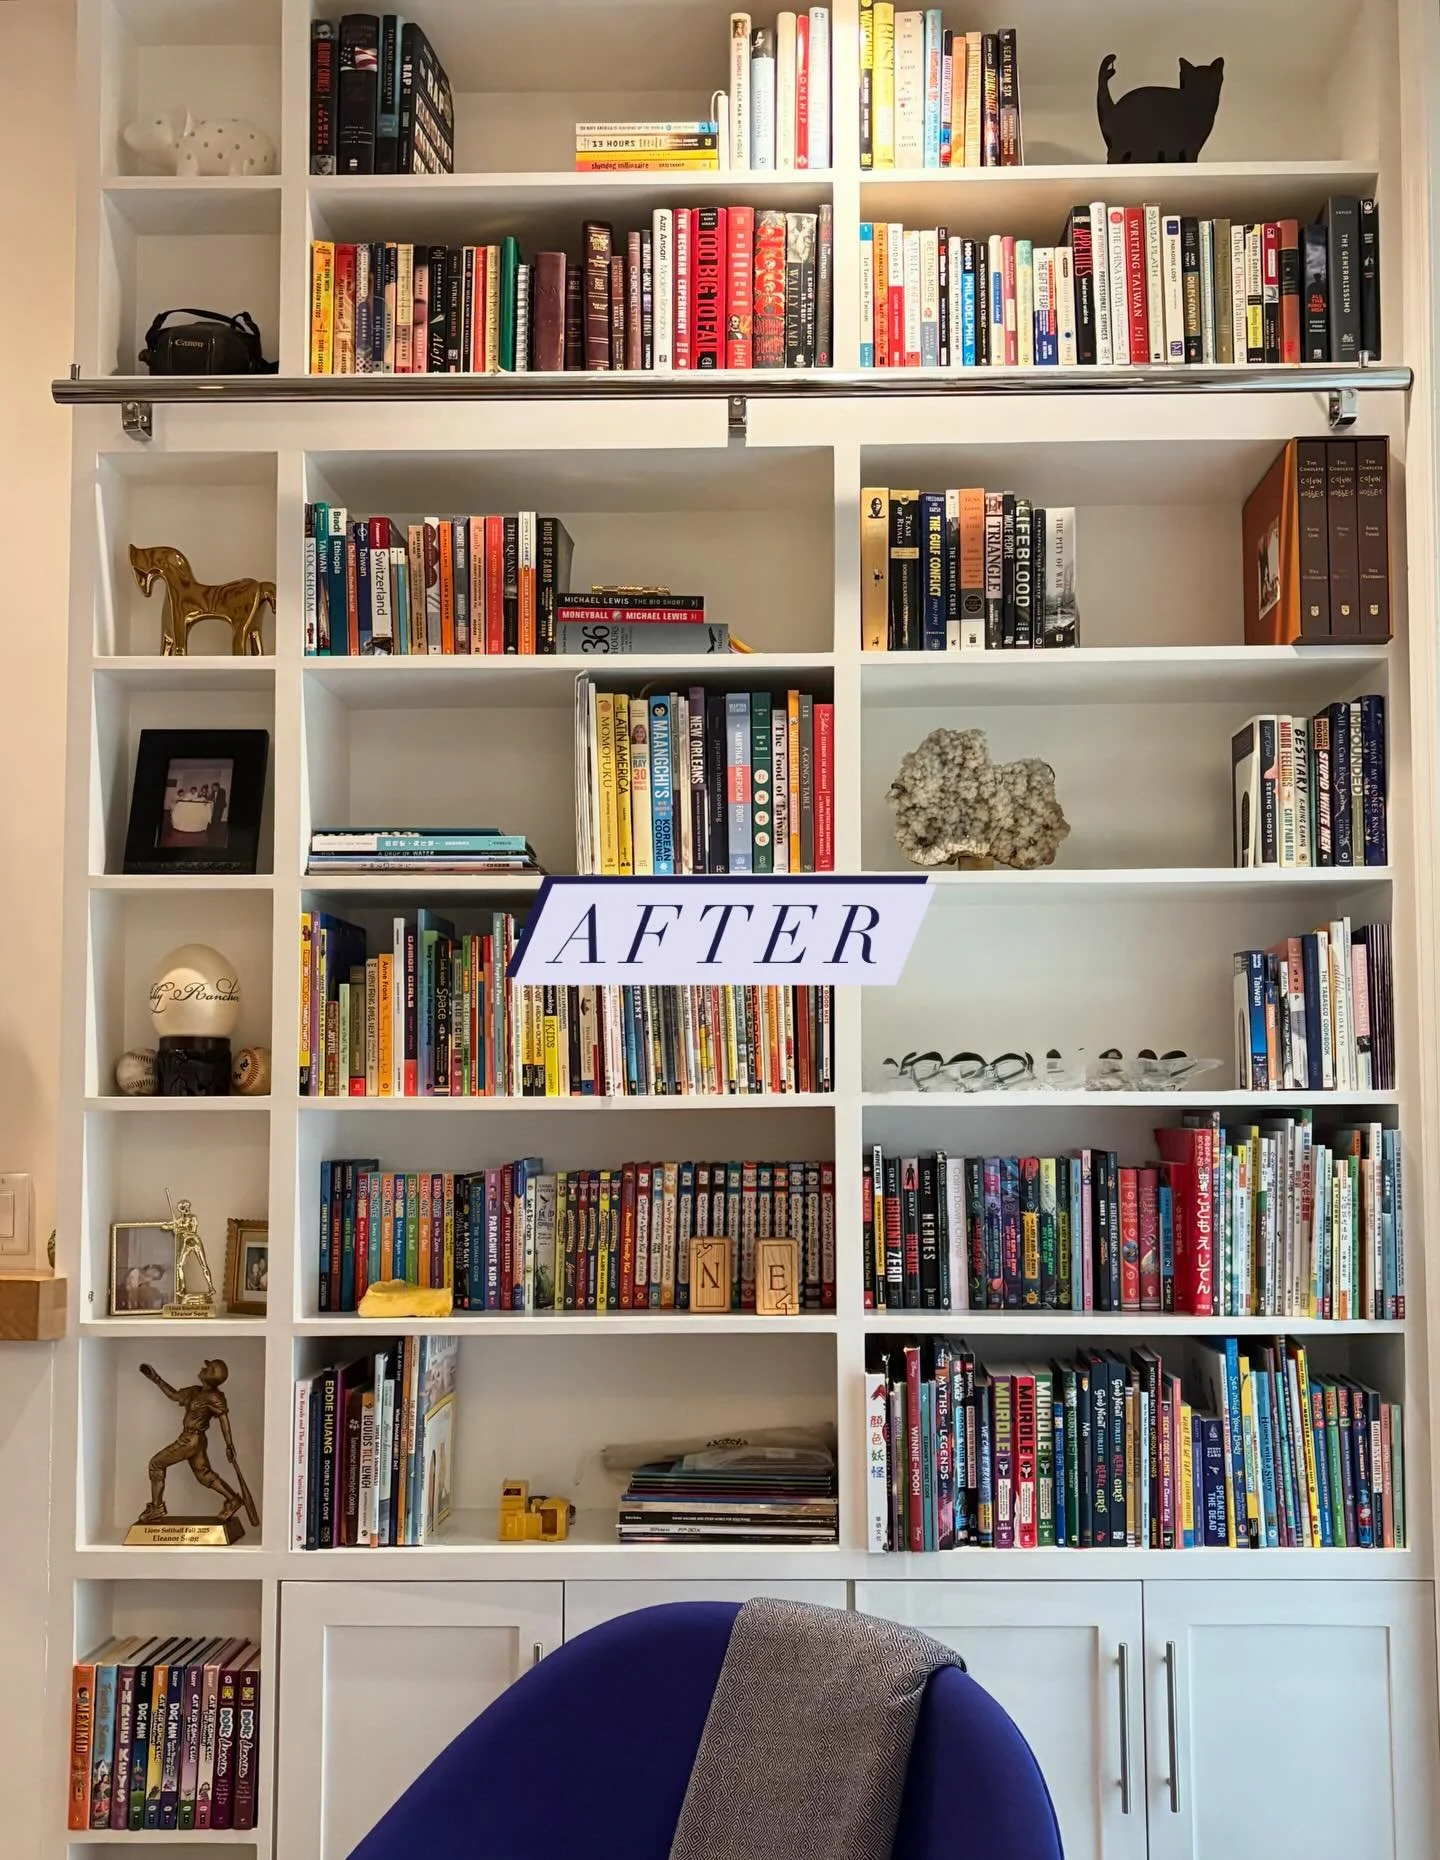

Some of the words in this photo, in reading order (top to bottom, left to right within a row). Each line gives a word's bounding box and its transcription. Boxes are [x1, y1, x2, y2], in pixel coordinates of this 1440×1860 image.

[403, 64, 412, 85] RAP
[985, 68, 996, 114] TROUBLEMAKER
[678, 213, 687, 229] THE
[660, 234, 668, 260] Ansari
[678, 233, 687, 275] BECKHAM
[698, 229, 717, 260] TOO
[1073, 228, 1092, 277] APPETITES
[1130, 219, 1140, 269] WRITING
[1233, 232, 1242, 262] Choke
[698, 265, 717, 293] BIG
[1038, 261, 1047, 271] THE
[1039, 272, 1048, 285] GIFT
[1234, 266, 1242, 294] Chuck
[789, 269, 799, 310] WALLY
[1132, 272, 1142, 317] TAIWAN
[1342, 251, 1350, 313] GENERALISSIMO
[678, 279, 687, 335] EXPERIMENT
[698, 296, 717, 313] TO
[965, 276, 974, 346] PHILADELPHIA
[1039, 295, 1048, 309] FEAR
[659, 300, 667, 339] Romance
[789, 314, 799, 347] LAMB
[174, 339, 204, 347] Canon
[432, 333, 443, 365] Aloft
[698, 321, 718, 353] FAIL
[544, 522, 552, 544] HOUSE
[930, 516, 941, 532] THE
[1004, 514, 1012, 533] MOLE
[544, 548, 551, 556] OF
[930, 534, 941, 556] GULF
[988, 522, 1001, 592] TRIANGLE
[1004, 535, 1013, 559] PEOPLE
[1016, 506, 1030, 607] LIFEBLOOD
[307, 543, 315, 612] STOCKHOLM
[360, 548, 368, 576] Taiwan
[505, 545, 515, 584] QUANTS
[543, 559, 552, 583] CARDS
[930, 558, 941, 596] CONFLICT
[1056, 558, 1063, 568] OF
[375, 552, 387, 616] Switzerland
[564, 596, 600, 604] MICHAEL
[663, 612, 688, 620] LEWIS
[616, 711, 628, 742] LATIN
[690, 716, 703, 737] NEW
[776, 725, 784, 747] The
[601, 716, 611, 788] MOMOFUKU
[653, 720, 668, 798] MAANGCHI'S
[690, 740, 704, 784] ORLEANS
[776, 752, 784, 780] Food
[1294, 729, 1307, 793] BESTIARY
[1351, 710, 1362, 794] IMPOUNDED
[617, 745, 628, 794] AMERICA
[1320, 751, 1329, 789] STUPID
[1371, 769, 1377, 780] MY
[776, 786, 785, 797] of
[776, 801, 786, 844] Taiwan
[1320, 792, 1330, 824] WHITE
[655, 819, 663, 861] COOKING
[662, 819, 671, 861] KOREAN
[1321, 827, 1331, 852] MEN
[1253, 976, 1262, 1006] Taiwan
[546, 1024, 555, 1048] KIDS
[886, 1197, 901, 1248] GROUND
[922, 1213, 935, 1260] HEROES
[489, 1216, 497, 1263] PARACHUTE
[905, 1233, 918, 1276] GRENADE
[489, 1266, 497, 1286] KIDS
[702, 1262, 720, 1288] N
[768, 1264, 787, 1290] E
[887, 1252, 902, 1282] ZERO
[324, 1380, 334, 1412] EDDIE
[938, 1376, 947, 1414] MYTHS
[981, 1425, 988, 1437] WE
[996, 1382, 1010, 1451] MURDLE
[1020, 1385, 1034, 1453] MURDLE
[1037, 1381, 1052, 1450] MURDLE
[1068, 1410, 1076, 1438] NARNIA
[1082, 1422, 1089, 1437] Me
[323, 1414, 333, 1454] HUANG
[940, 1429, 948, 1480] LEGENDS
[982, 1456, 989, 1466] BE
[912, 1469, 920, 1495] POOH
[1216, 1485, 1224, 1520] SPEAKER
[1217, 1522, 1225, 1538] FOR
[138, 1703, 148, 1720] DOG
[170, 1703, 179, 1720] DOG
[241, 1710, 253, 1738] DORK
[75, 1702, 89, 1754] MEXIKID
[137, 1722, 147, 1739] MAN
[168, 1722, 178, 1738] MAN
[239, 1740, 253, 1777] diaries
